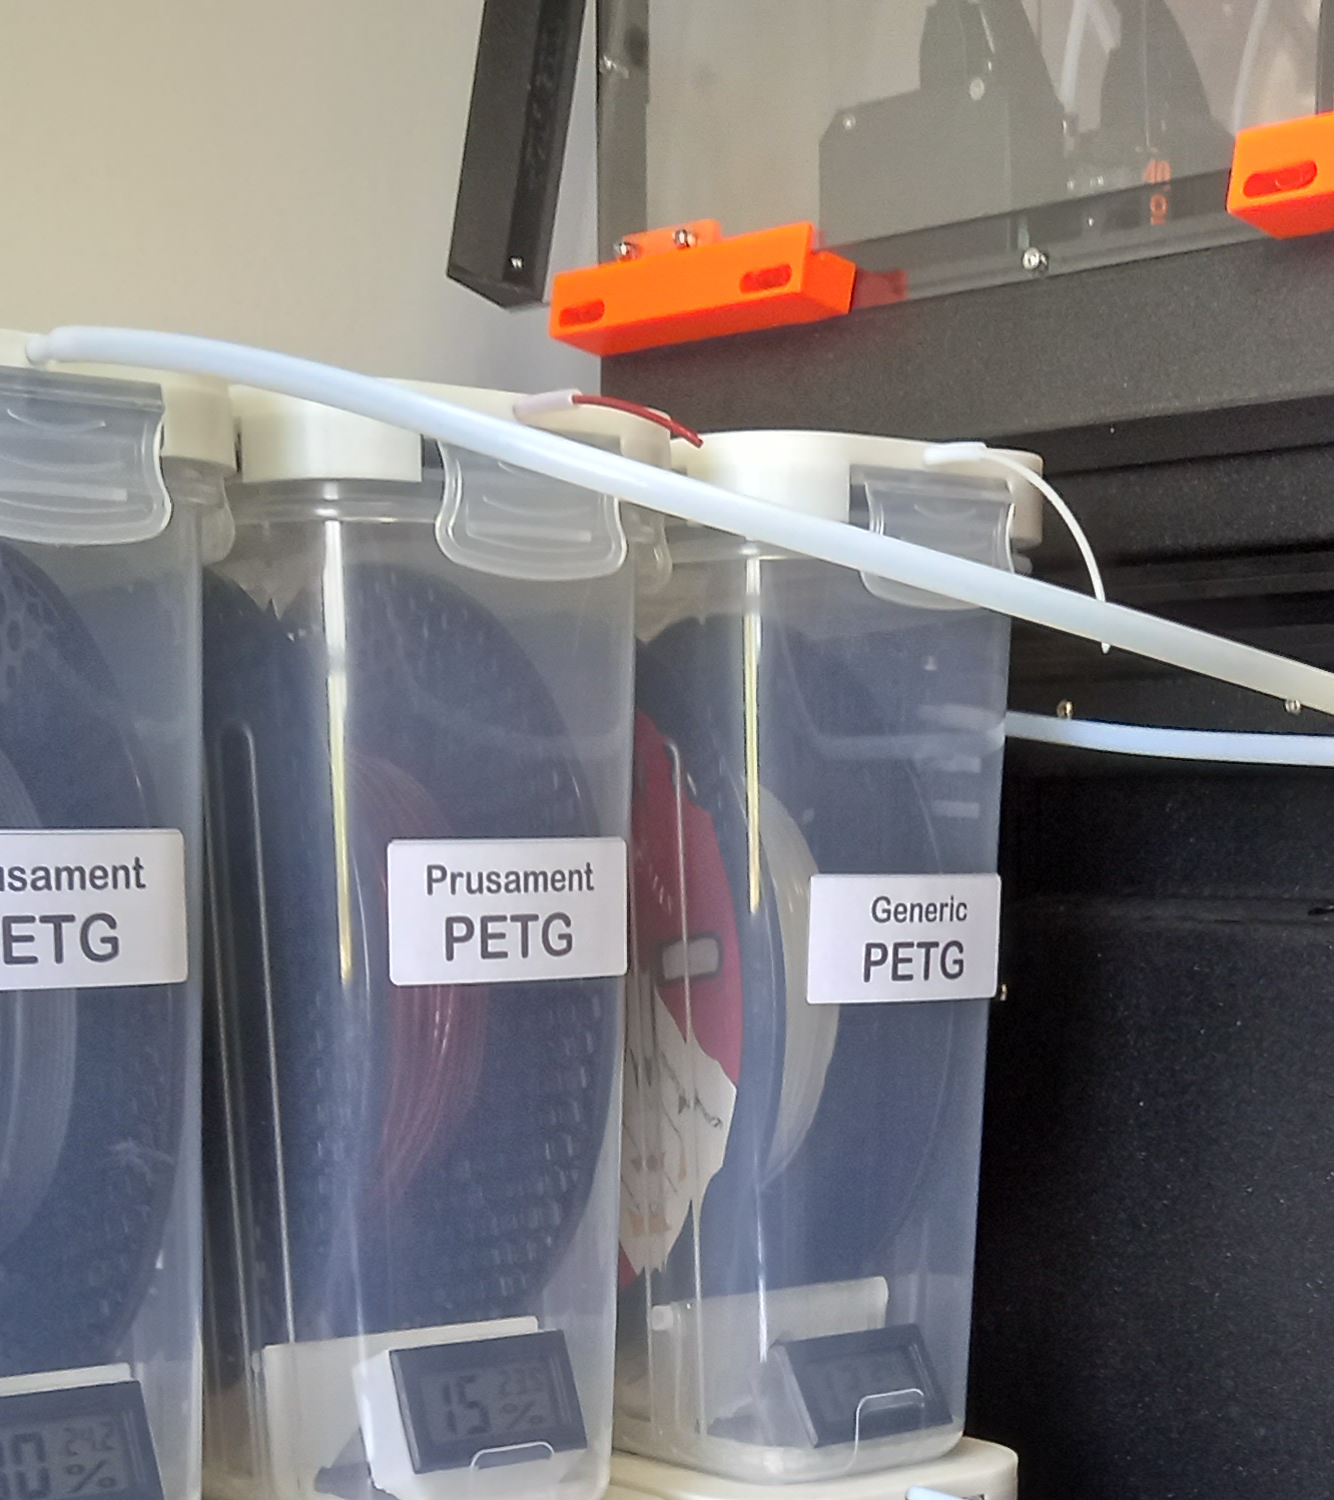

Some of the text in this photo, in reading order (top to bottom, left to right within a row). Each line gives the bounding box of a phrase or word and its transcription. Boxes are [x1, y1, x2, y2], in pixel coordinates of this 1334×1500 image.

[426, 862, 595, 896] Prusament
[871, 895, 968, 923] Generic
[444, 912, 574, 962] PETG
[862, 940, 965, 983] PETG
[441, 1374, 492, 1435] 15
